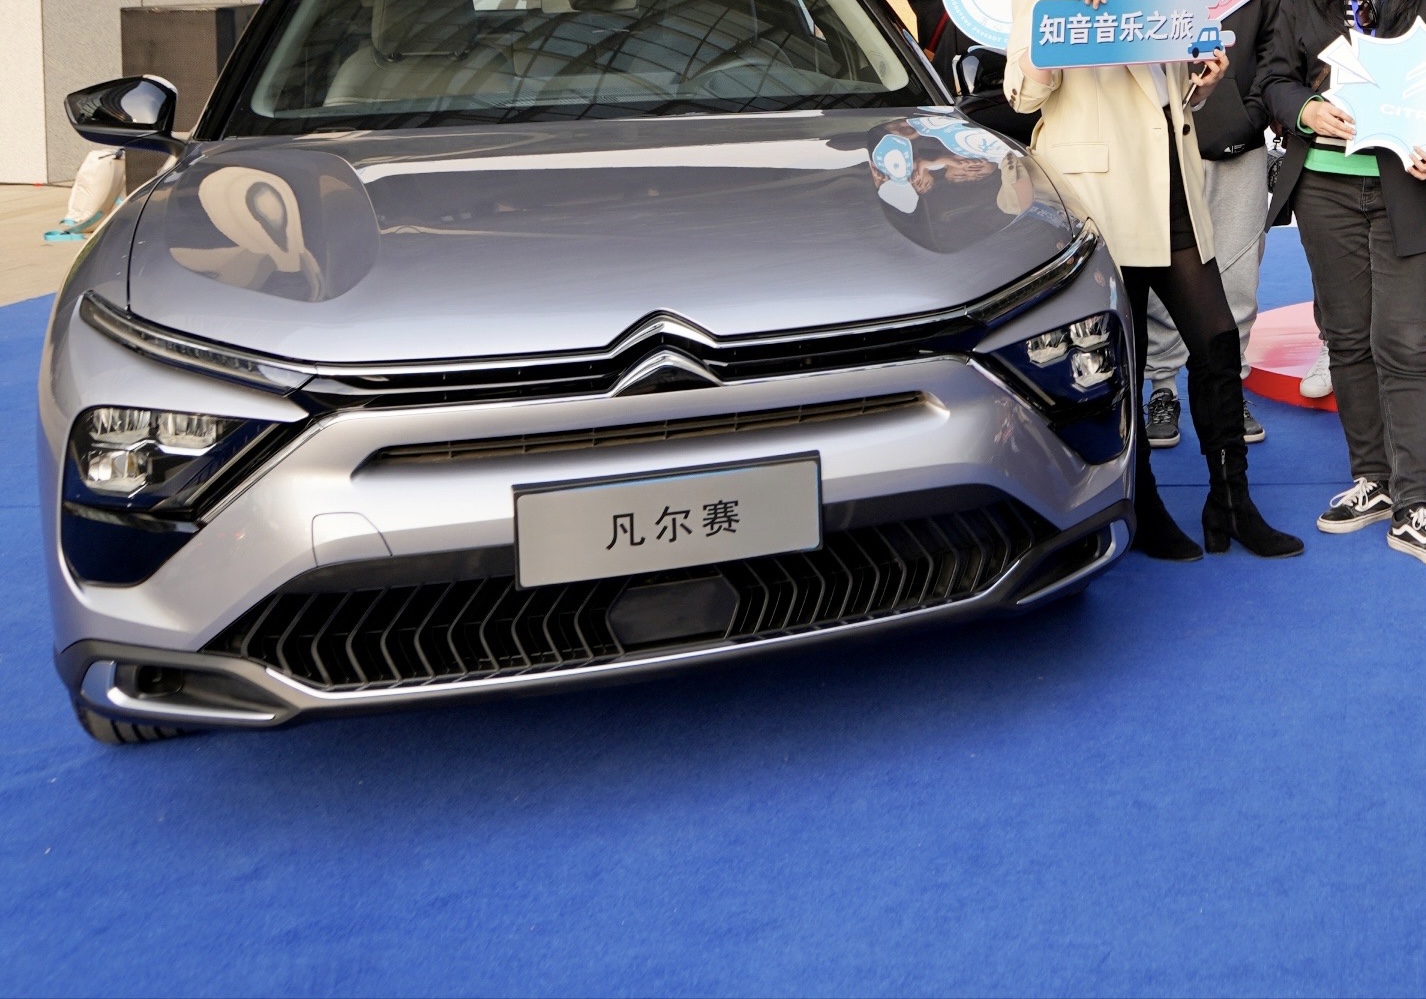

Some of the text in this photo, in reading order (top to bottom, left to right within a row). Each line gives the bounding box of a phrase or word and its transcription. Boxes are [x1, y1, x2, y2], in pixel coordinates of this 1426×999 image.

[1038, 9, 1194, 46] 知音音乐之旅
[606, 499, 741, 550] 凡尔赛
